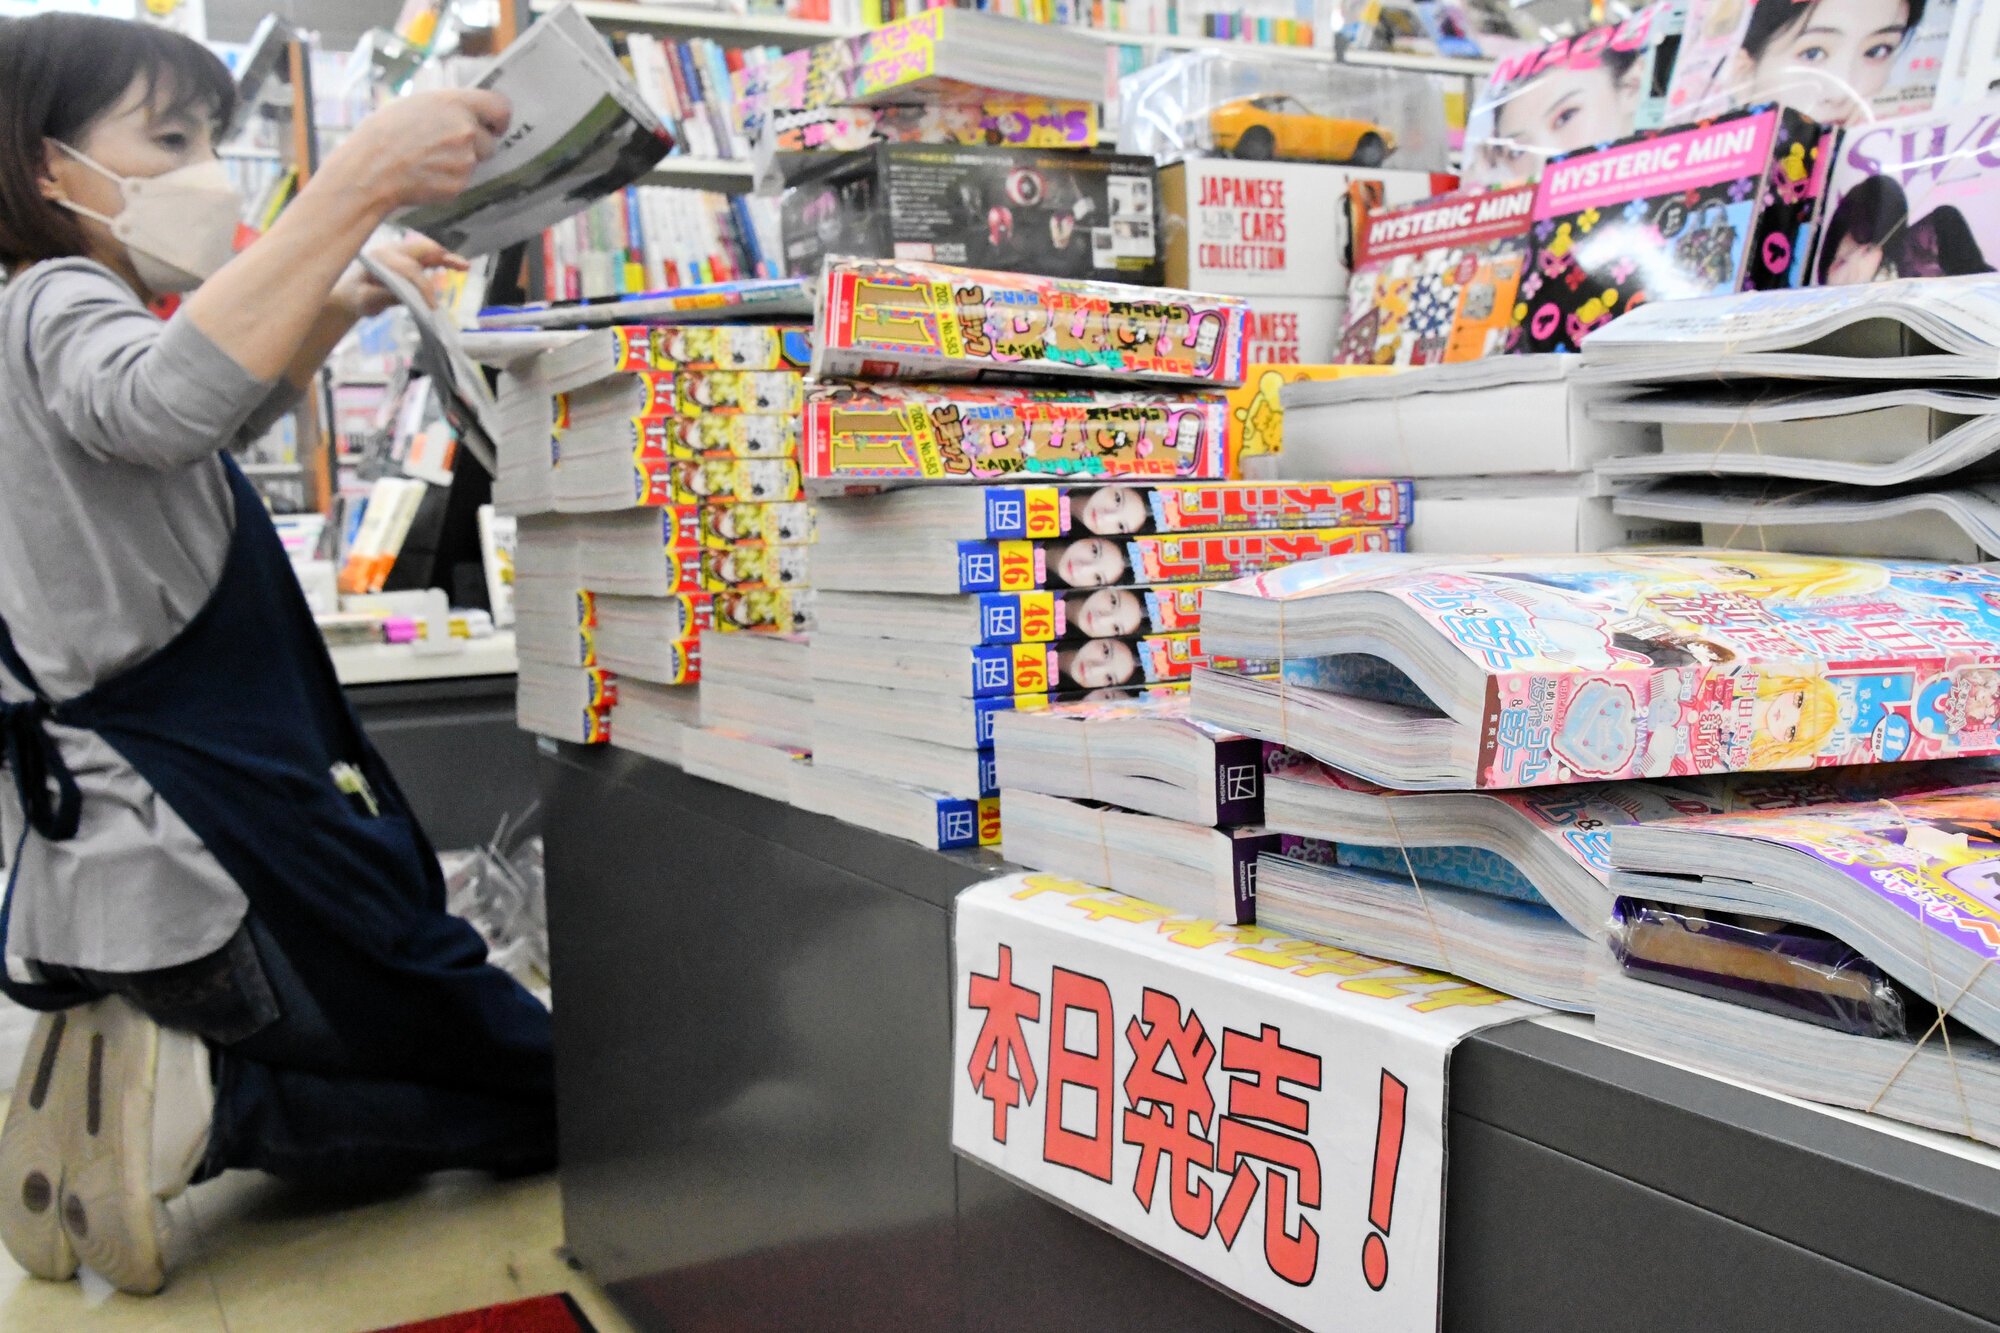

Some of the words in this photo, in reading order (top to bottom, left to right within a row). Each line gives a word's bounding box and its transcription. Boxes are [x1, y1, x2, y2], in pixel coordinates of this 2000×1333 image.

[1550, 140, 1684, 194] HYSTERIC
[1686, 126, 1757, 164] MINI
[1198, 176, 1285, 209] JAPANESE
[1240, 212, 1286, 242] CARS
[1368, 202, 1475, 245] HYSTERIC
[1477, 190, 1533, 218] MINI
[1198, 244, 1286, 270] COLLECTION
[941, 323, 960, 358] No.583
[918, 441, 938, 478] No.583
[1029, 498, 1055, 532] 46
[1002, 551, 1030, 584] 46
[1023, 603, 1050, 637] 46
[1647, 591, 1787, 627] 新作
[1441, 614, 1536, 670] ミラー
[1715, 612, 1998, 660] 村田真優
[1016, 654, 1044, 688] 46
[1543, 680, 1557, 722] ゆめいろ
[1729, 671, 1760, 769] 村田真優
[1486, 713, 1499, 750] 集英社
[1496, 709, 1529, 773] ミラー
[1695, 713, 1723, 769] 新作
[1219, 764, 1227, 805] KODANSHA
[1240, 860, 1248, 902] KODANSHA
[966, 943, 1409, 1293] 本日発売！
